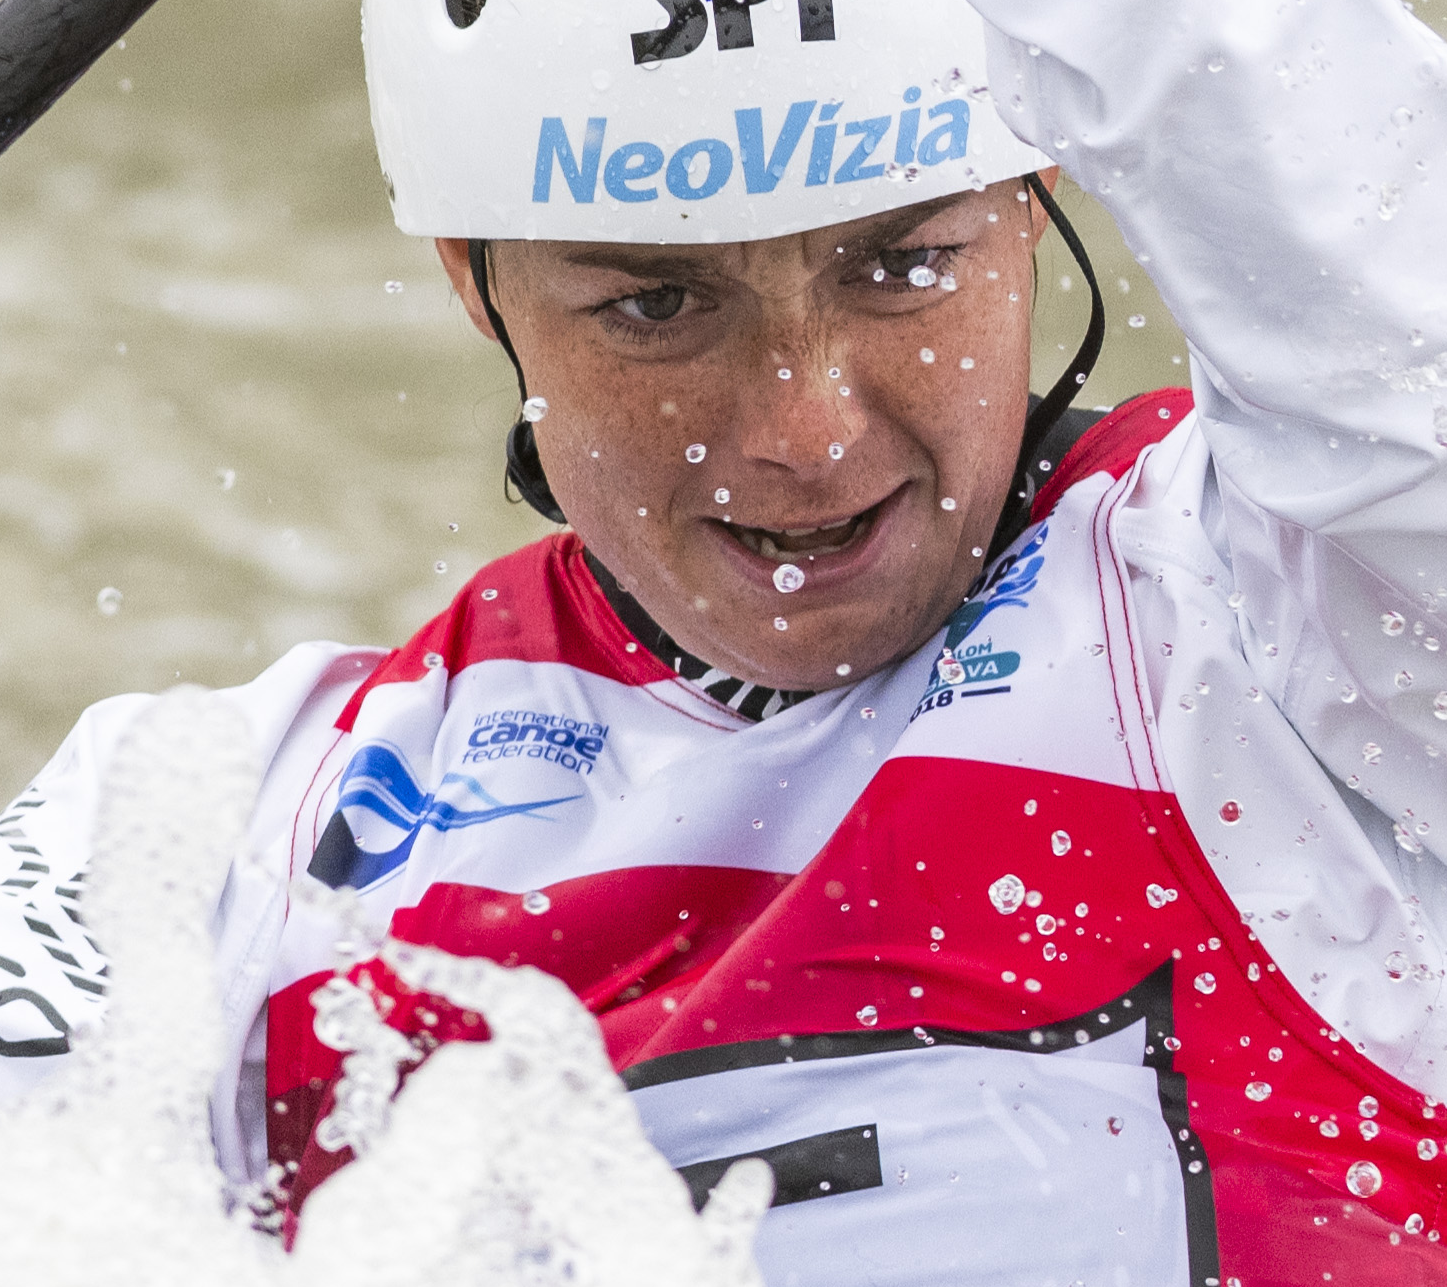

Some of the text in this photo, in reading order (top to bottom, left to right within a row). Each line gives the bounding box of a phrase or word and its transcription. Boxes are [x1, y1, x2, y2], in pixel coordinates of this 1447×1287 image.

[532, 86, 971, 204] NeoVízia
[468, 722, 603, 761] canoe
[474, 710, 609, 739] international
[462, 743, 594, 775] federation
